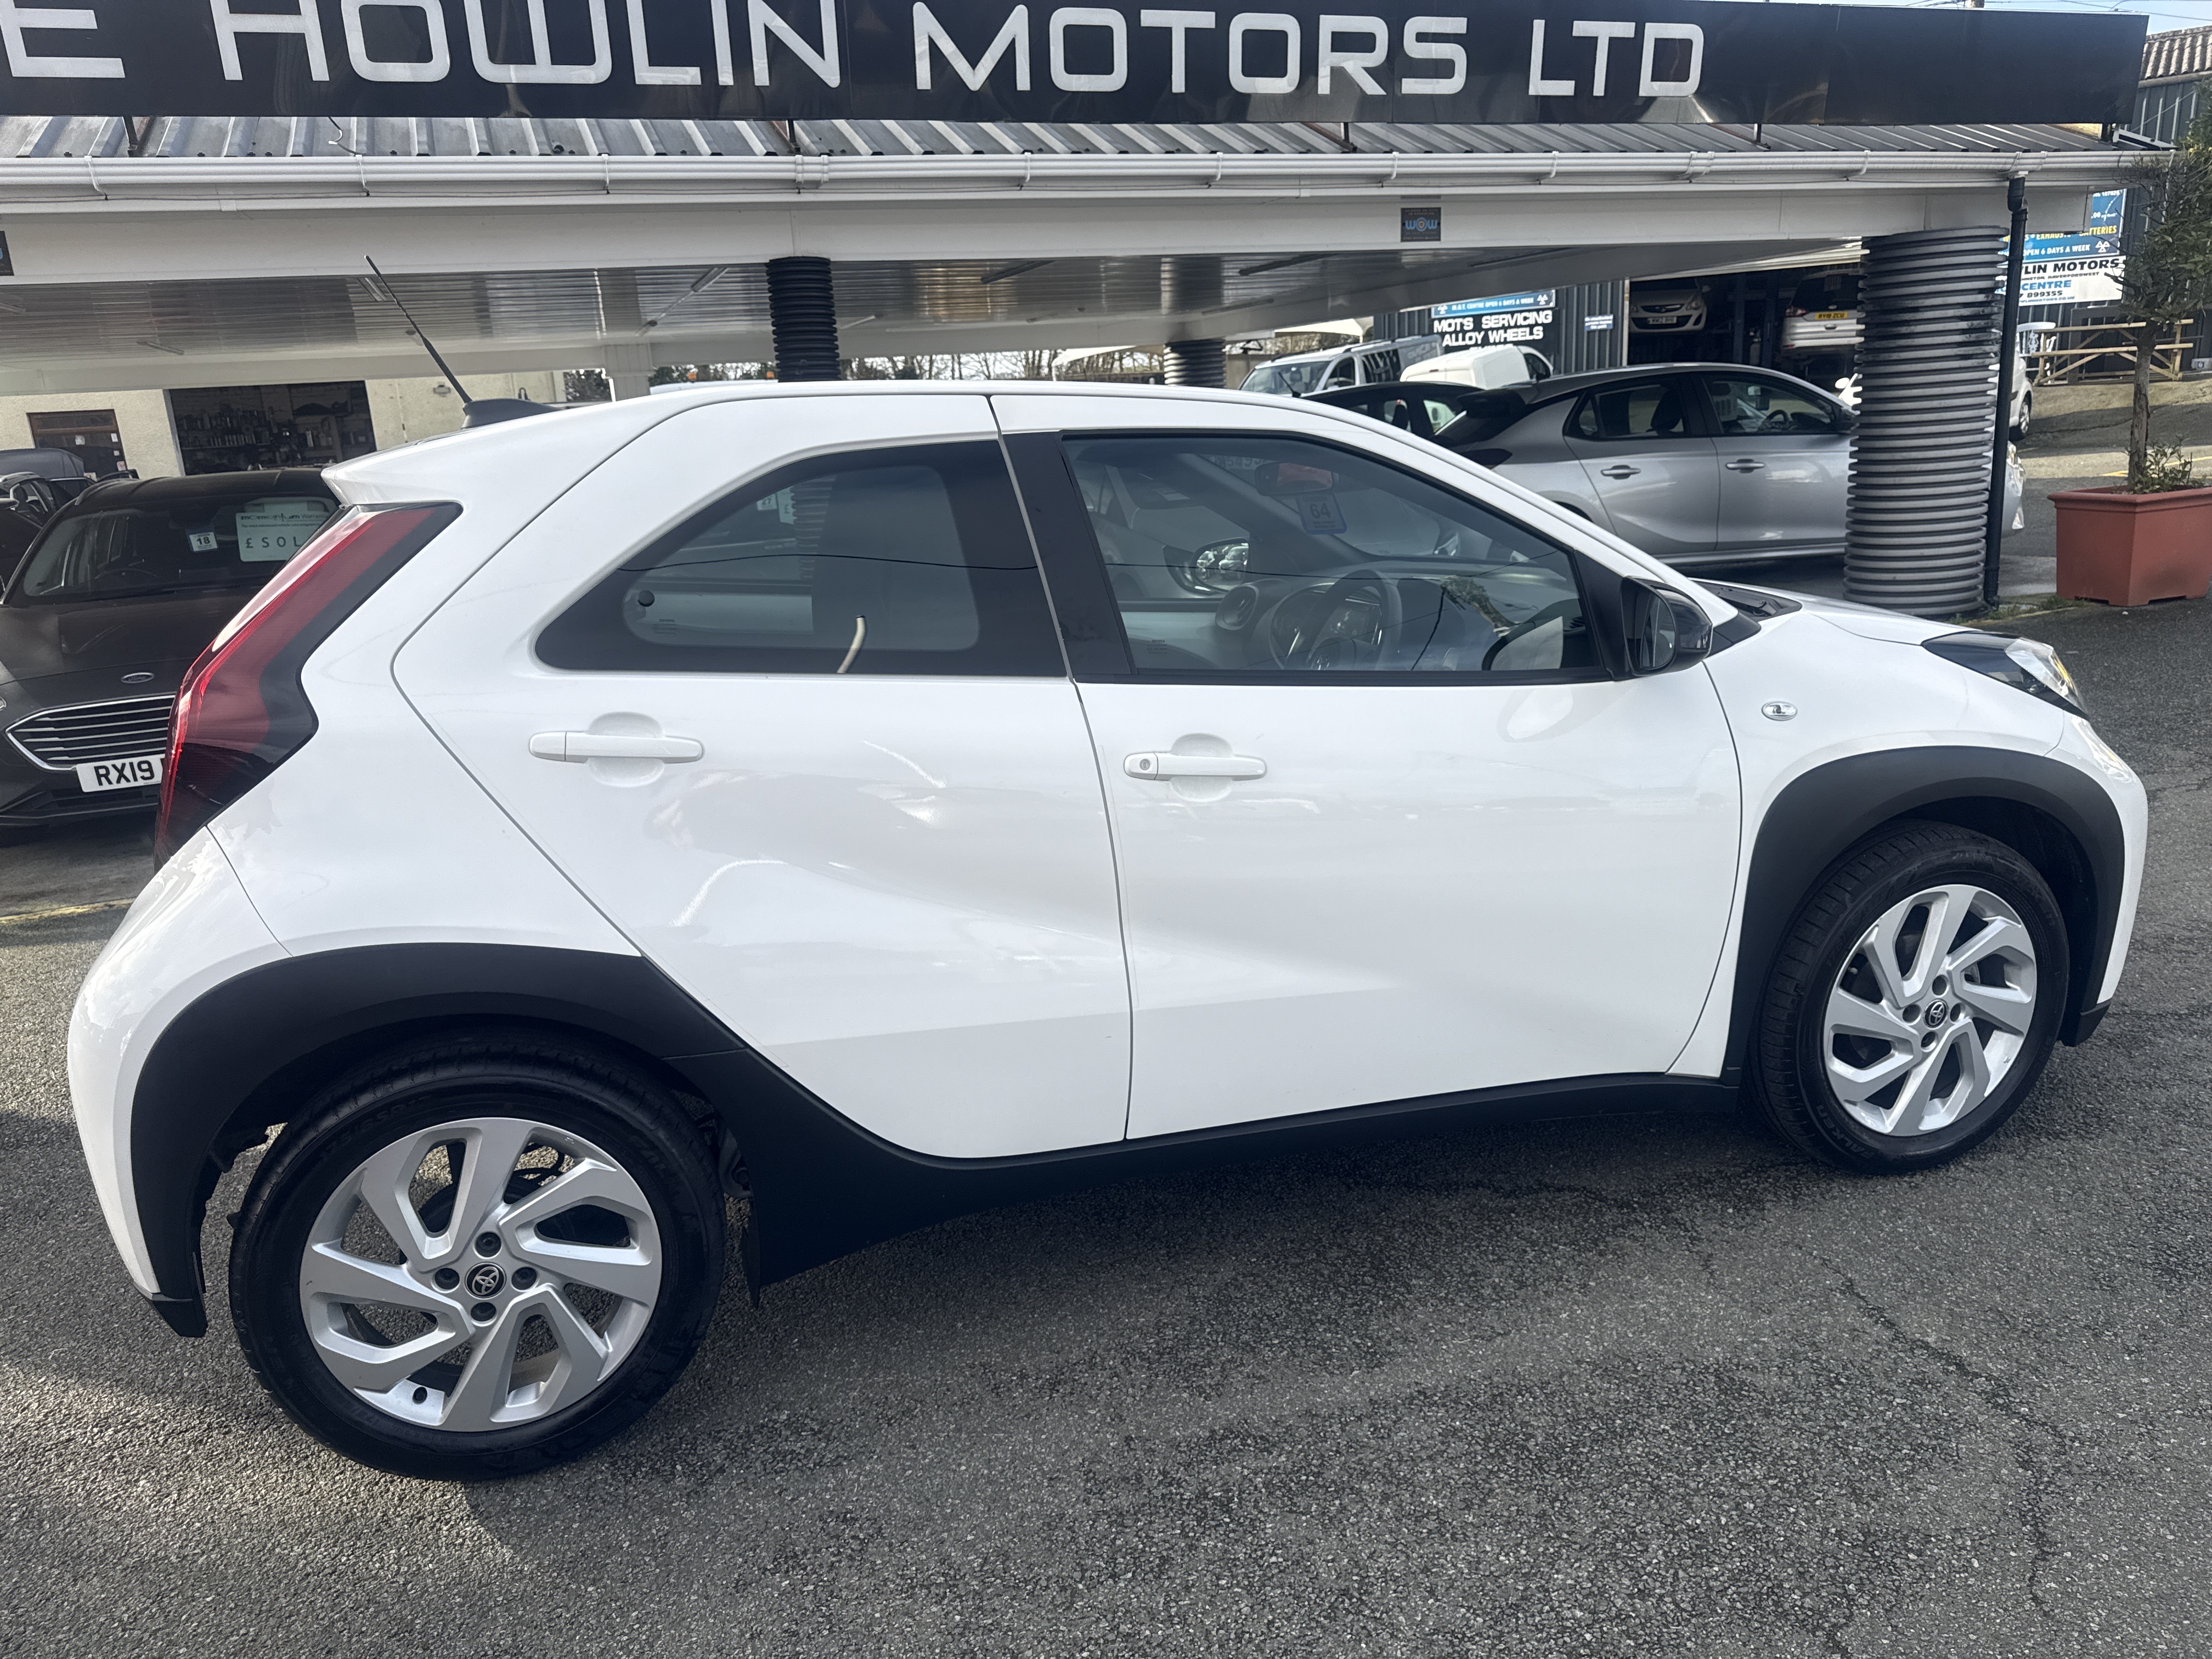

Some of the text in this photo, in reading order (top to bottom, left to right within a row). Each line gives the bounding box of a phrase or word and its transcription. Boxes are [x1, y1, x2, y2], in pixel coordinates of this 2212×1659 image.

[210, 0, 840, 88] HOWLIN
[913, 2, 1468, 95] MOTORS
[1528, 19, 1704, 97] LTD
[2079, 225, 2117, 237] TTERIES
[2022, 258, 2119, 274] LIN MOTORS
[2022, 280, 2072, 291] CENTRE
[1482, 310, 1553, 329] SERVICING
[1442, 326, 1544, 347] ALLOY WHEELS
[1310, 503, 1331, 518] 64
[196, 537, 211, 545] 18
[261, 536, 302, 548] SOL
[93, 760, 155, 786] RX19
